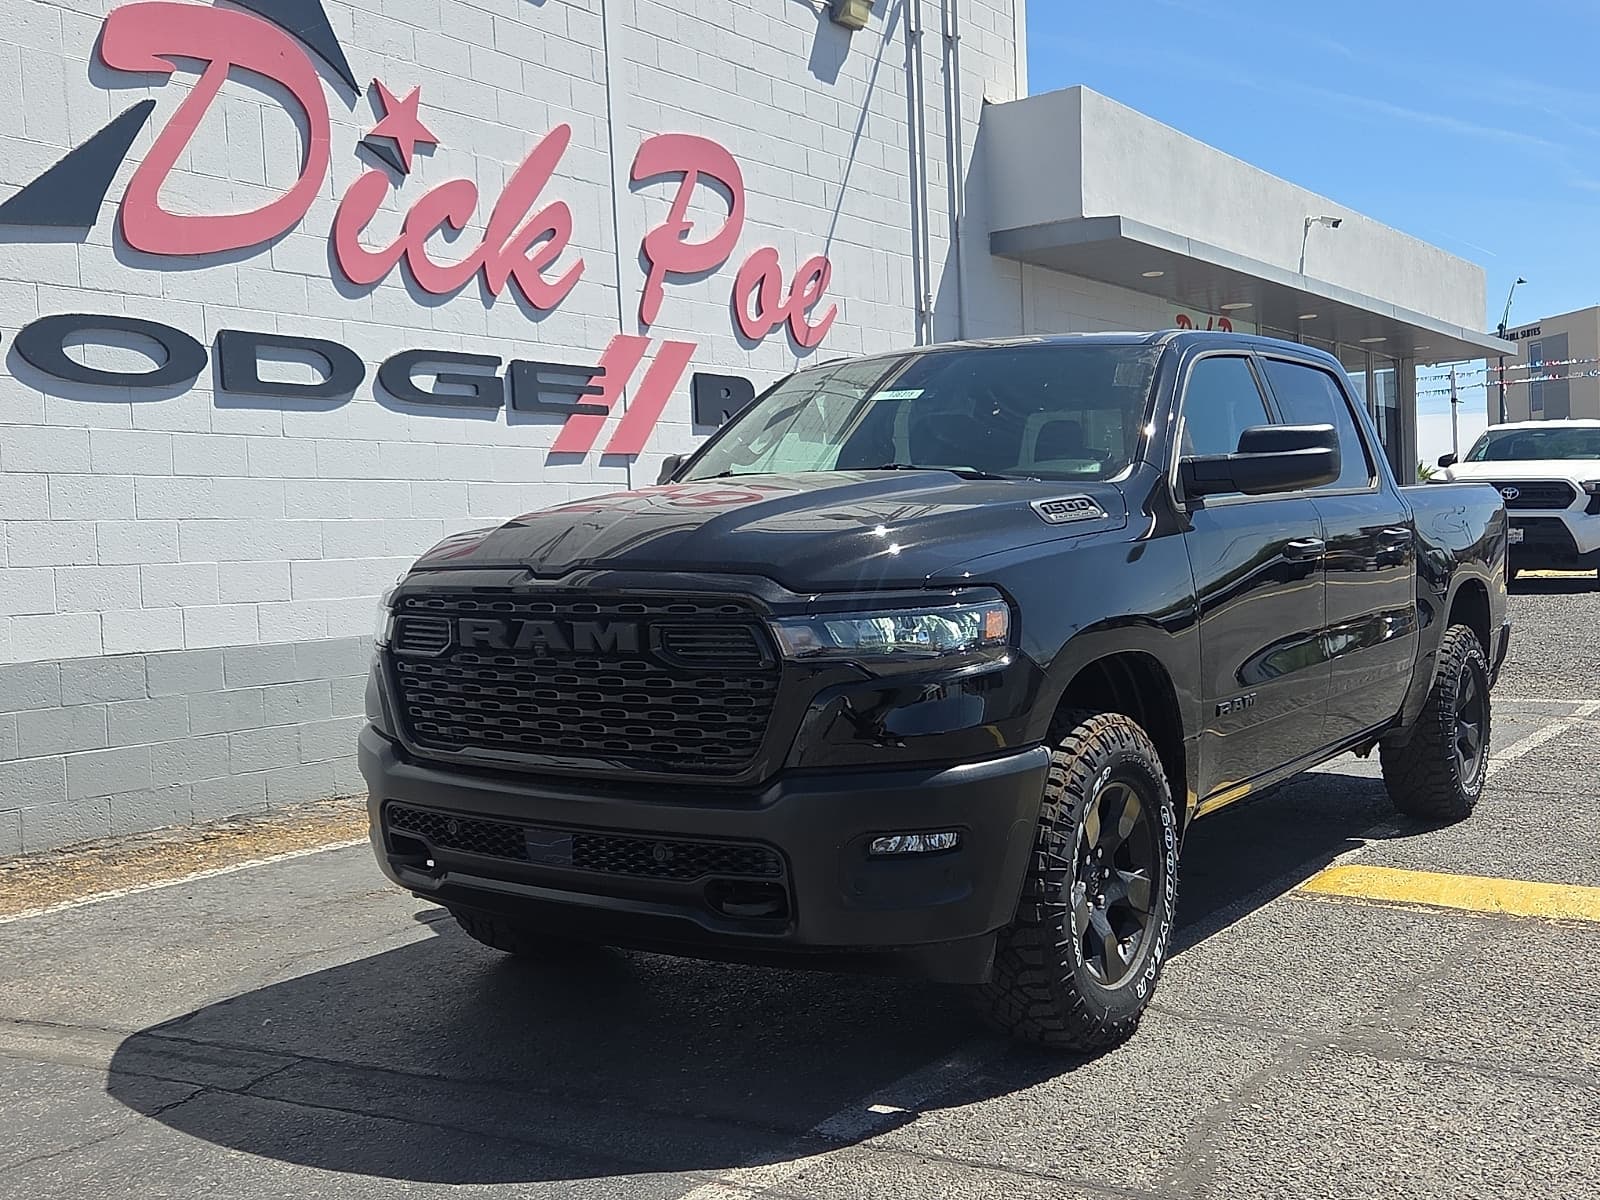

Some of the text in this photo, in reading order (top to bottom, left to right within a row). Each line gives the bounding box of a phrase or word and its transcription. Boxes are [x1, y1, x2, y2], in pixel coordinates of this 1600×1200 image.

[101, 2, 837, 347] Dick Poe
[1520, 327, 1541, 339] SUITES
[0, 312, 755, 428] ODGE R
[1040, 499, 1090, 514] 1500
[457, 617, 640, 652] RAM
[1215, 692, 1257, 717] RAM
[1137, 804, 1178, 1000] GOODYEAR
